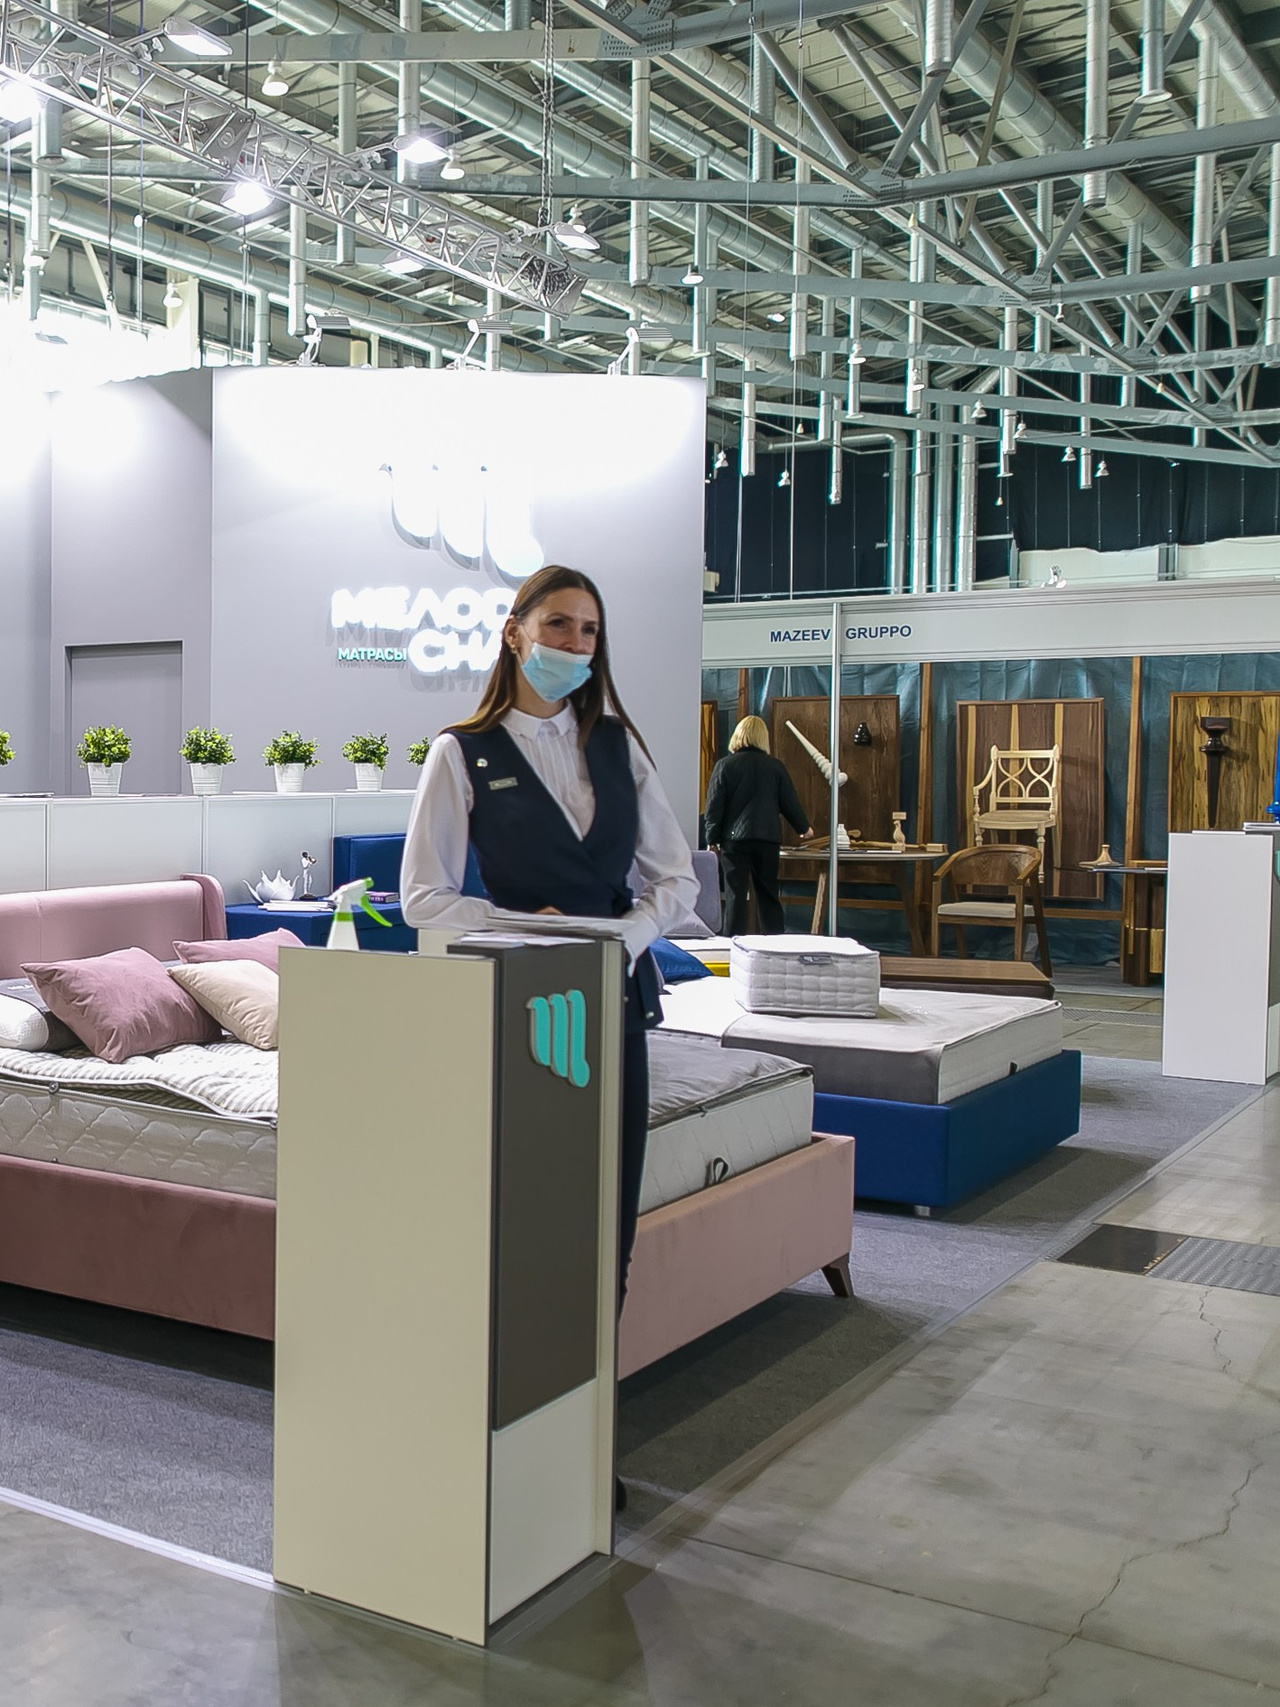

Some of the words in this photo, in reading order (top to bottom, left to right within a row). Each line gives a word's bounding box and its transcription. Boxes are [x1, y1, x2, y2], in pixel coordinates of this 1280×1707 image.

[770, 628, 831, 643] MAZEEV
[845, 624, 912, 640] GRUPPO
[337, 647, 407, 662] МАТРАСЫ
